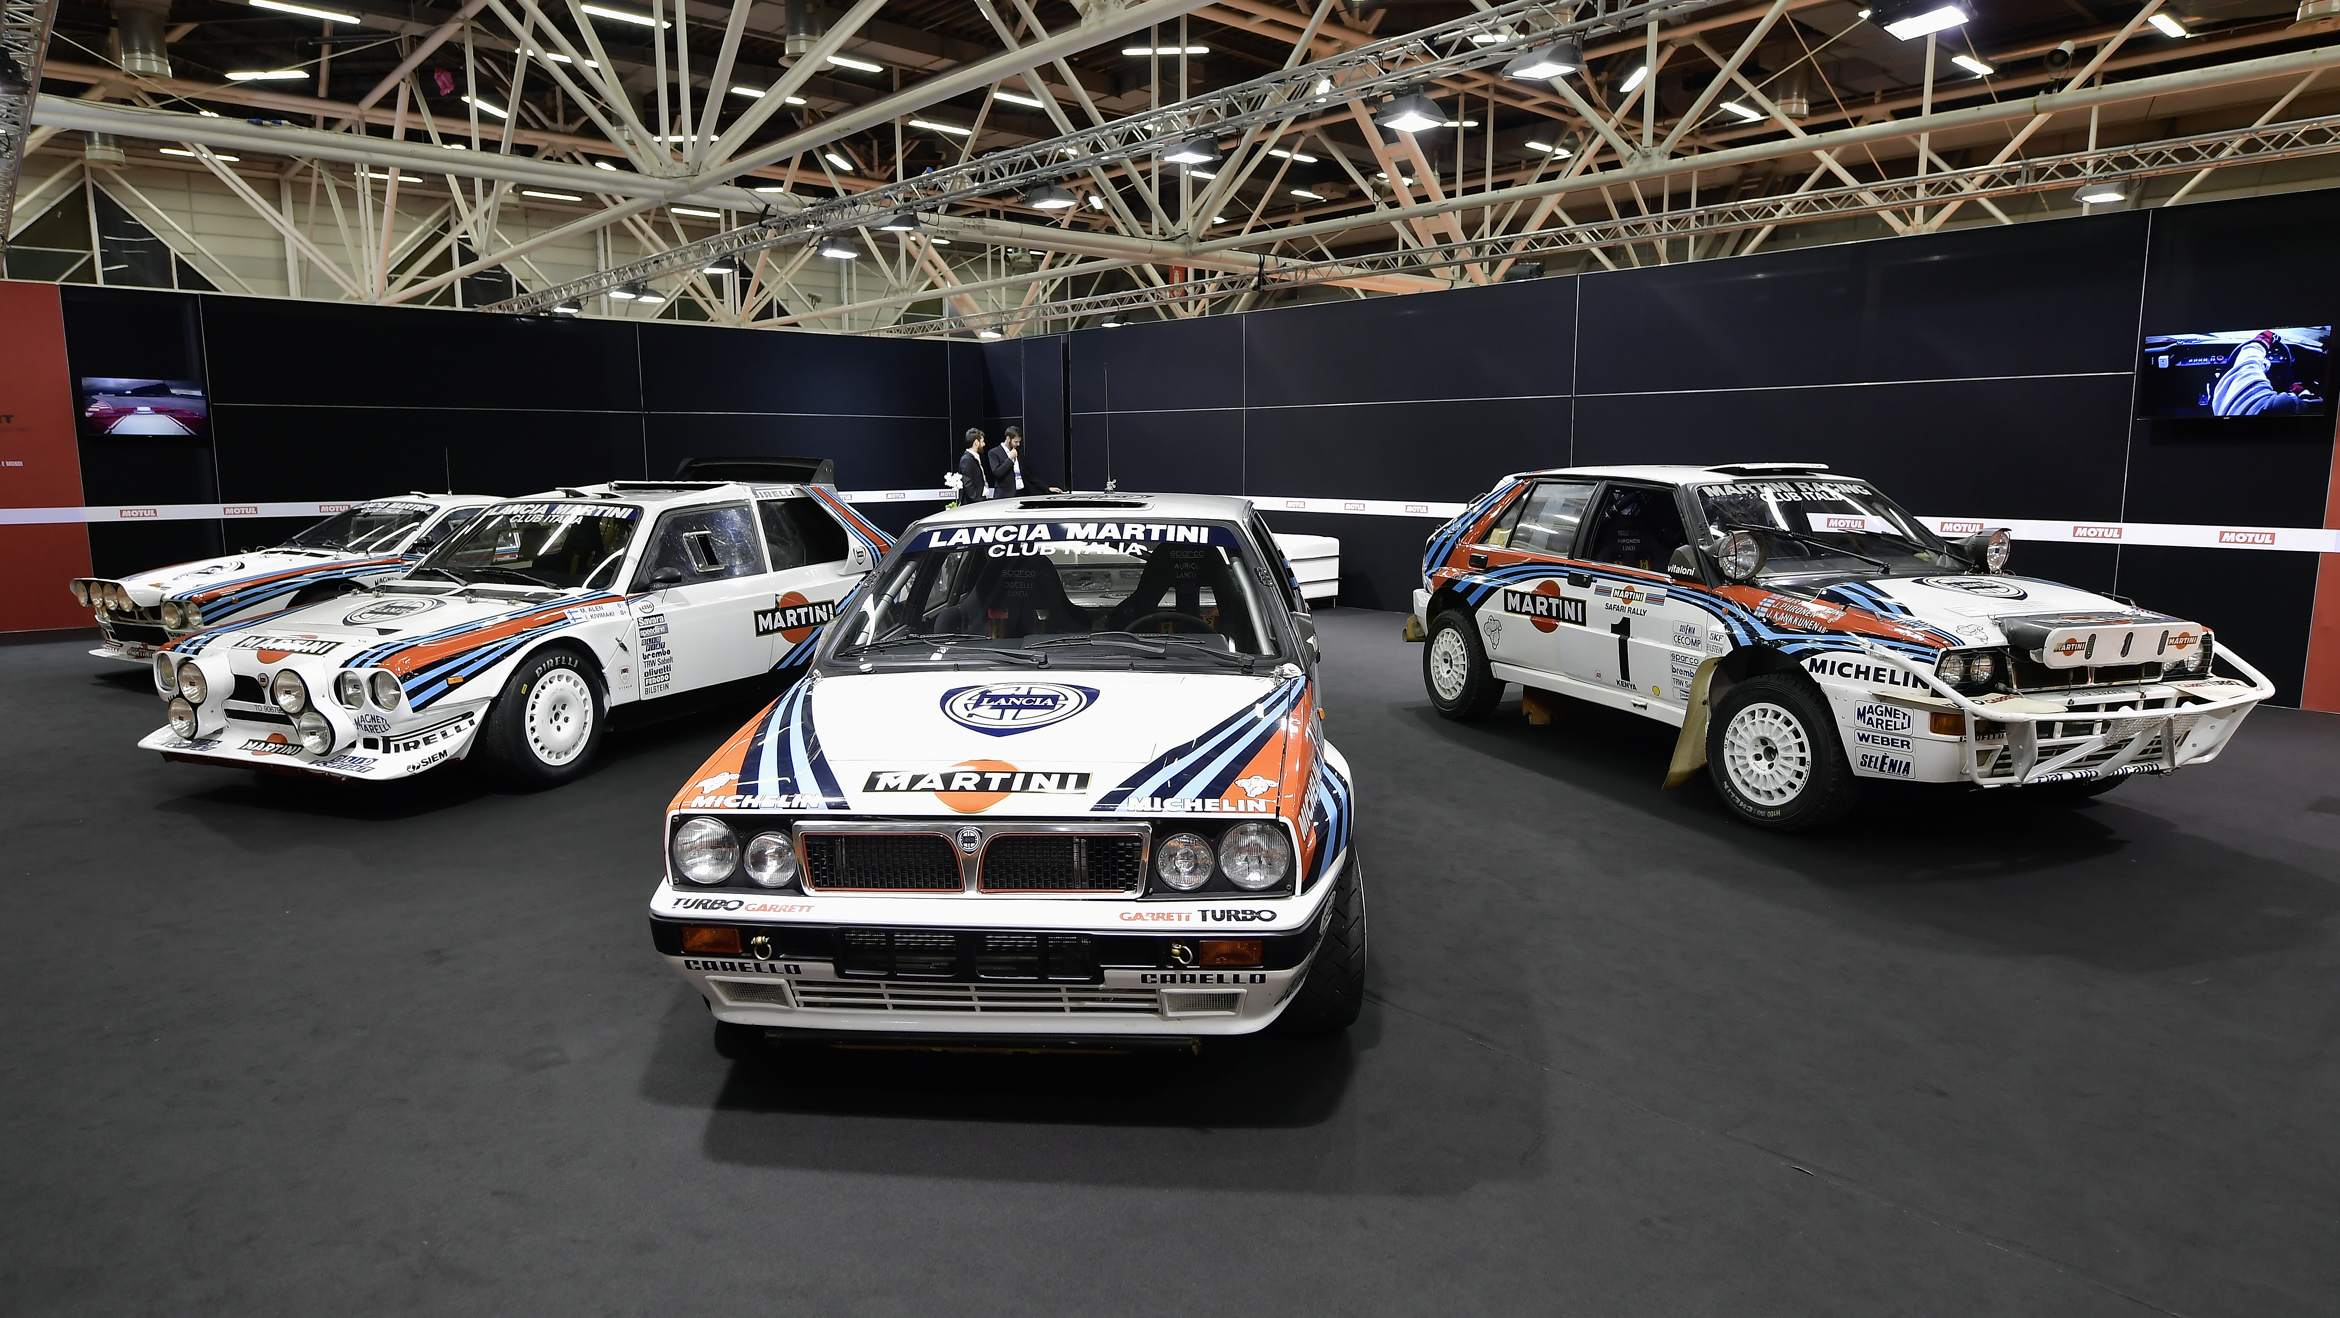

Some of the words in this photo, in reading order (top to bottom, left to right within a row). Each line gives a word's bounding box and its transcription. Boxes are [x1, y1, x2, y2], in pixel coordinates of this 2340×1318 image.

[1701, 482, 1796, 497] MARTINI
[1798, 482, 1872, 496] RACING
[121, 509, 156, 517] MOTUL
[225, 507, 257, 515] MOTUL
[490, 503, 547, 515] LANCIA
[551, 504, 634, 519] MARTINI
[510, 514, 544, 523] CLUB
[1828, 518, 1865, 529] MOTUL
[1942, 522, 1983, 532] MOTUL
[2074, 526, 2121, 538] MOTUL
[928, 523, 1051, 548] LANCIA
[1064, 522, 1209, 544] MARTINI
[2221, 532, 2275, 544] MOTUL
[988, 541, 1057, 558] CLUB
[1667, 564, 1695, 576] vitaloni
[1613, 589, 1644, 601] MARTINI
[1506, 592, 1584, 623] MARTINI
[1604, 602, 1627, 612] SAFARI
[1626, 605, 1648, 617] RALLY
[757, 603, 835, 633] MARTINI
[1673, 634, 1702, 648] CECOMP
[2168, 636, 2197, 646] MARTINI
[642, 648, 671, 660] brembo
[1611, 616, 1631, 682] 1
[535, 656, 578, 678] PIRELLI
[644, 664, 672, 678] olivetti
[1671, 664, 1695, 678] bremb
[644, 682, 670, 695] BILSTEIN
[981, 694, 1054, 707] LANCIA
[1856, 704, 1911, 722] MAGNETI
[1856, 731, 1911, 750] WEBER
[243, 741, 303, 755] MARTINI
[420, 749, 448, 767] SIEM
[873, 771, 1083, 793] MARTINI
[690, 794, 822, 810] MICHELIN
[1126, 796, 1270, 813] MICHELIN
[672, 897, 744, 912] TURBO
[744, 903, 816, 913] GARRETT
[1119, 911, 1193, 922] GARRETT
[1197, 909, 1278, 923] TURBO
[683, 959, 803, 976] CARELLO
[1140, 973, 1267, 985] CARELLO
